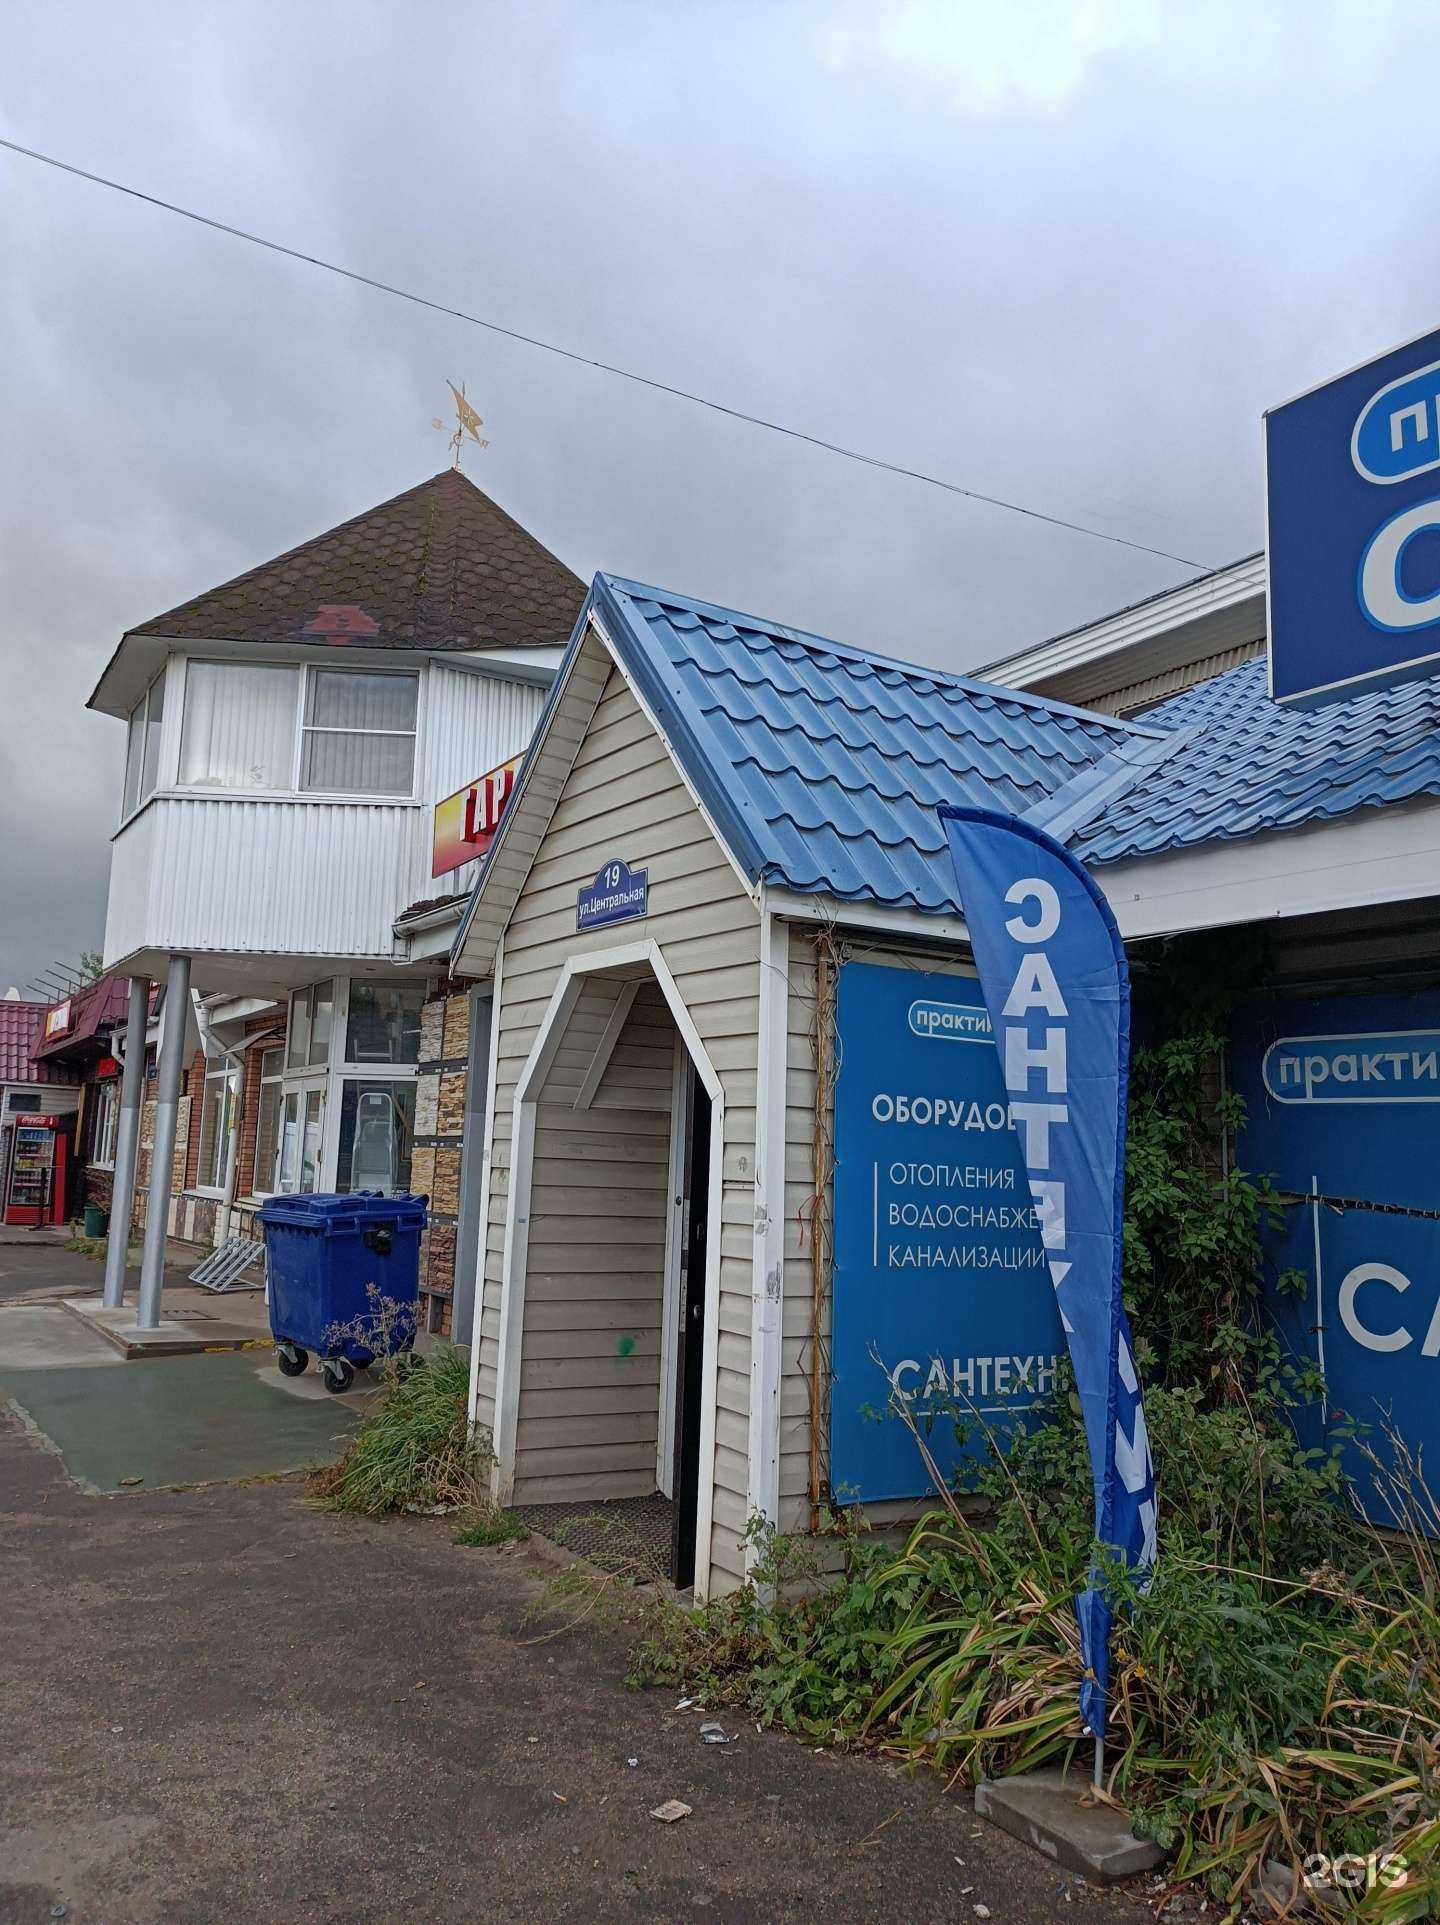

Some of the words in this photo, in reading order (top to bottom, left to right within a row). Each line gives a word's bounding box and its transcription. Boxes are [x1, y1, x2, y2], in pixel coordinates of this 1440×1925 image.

[604, 865, 620, 889] 19
[889, 1162, 1015, 1190] ОТОПЛЕНИЯ
[889, 1244, 1045, 1271] КАНАЛИЗАЦИИ
[891, 1354, 1068, 1401] САНТЕХН
